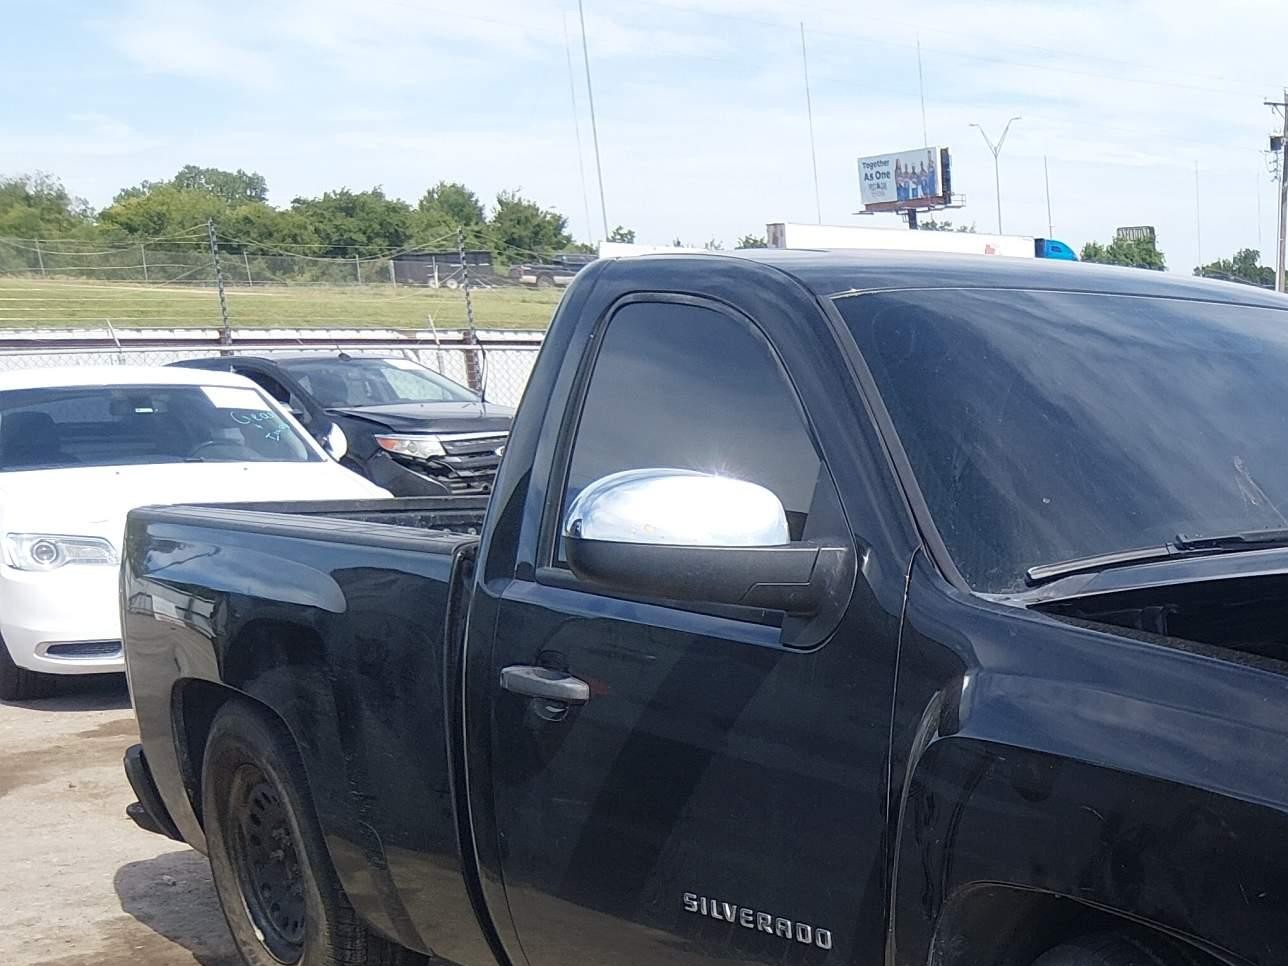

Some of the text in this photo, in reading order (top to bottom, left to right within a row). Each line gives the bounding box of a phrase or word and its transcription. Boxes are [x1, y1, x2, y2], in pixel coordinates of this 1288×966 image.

[862, 160, 889, 171] Together
[864, 171, 891, 181] As One
[683, 891, 833, 950] SILVERADO
